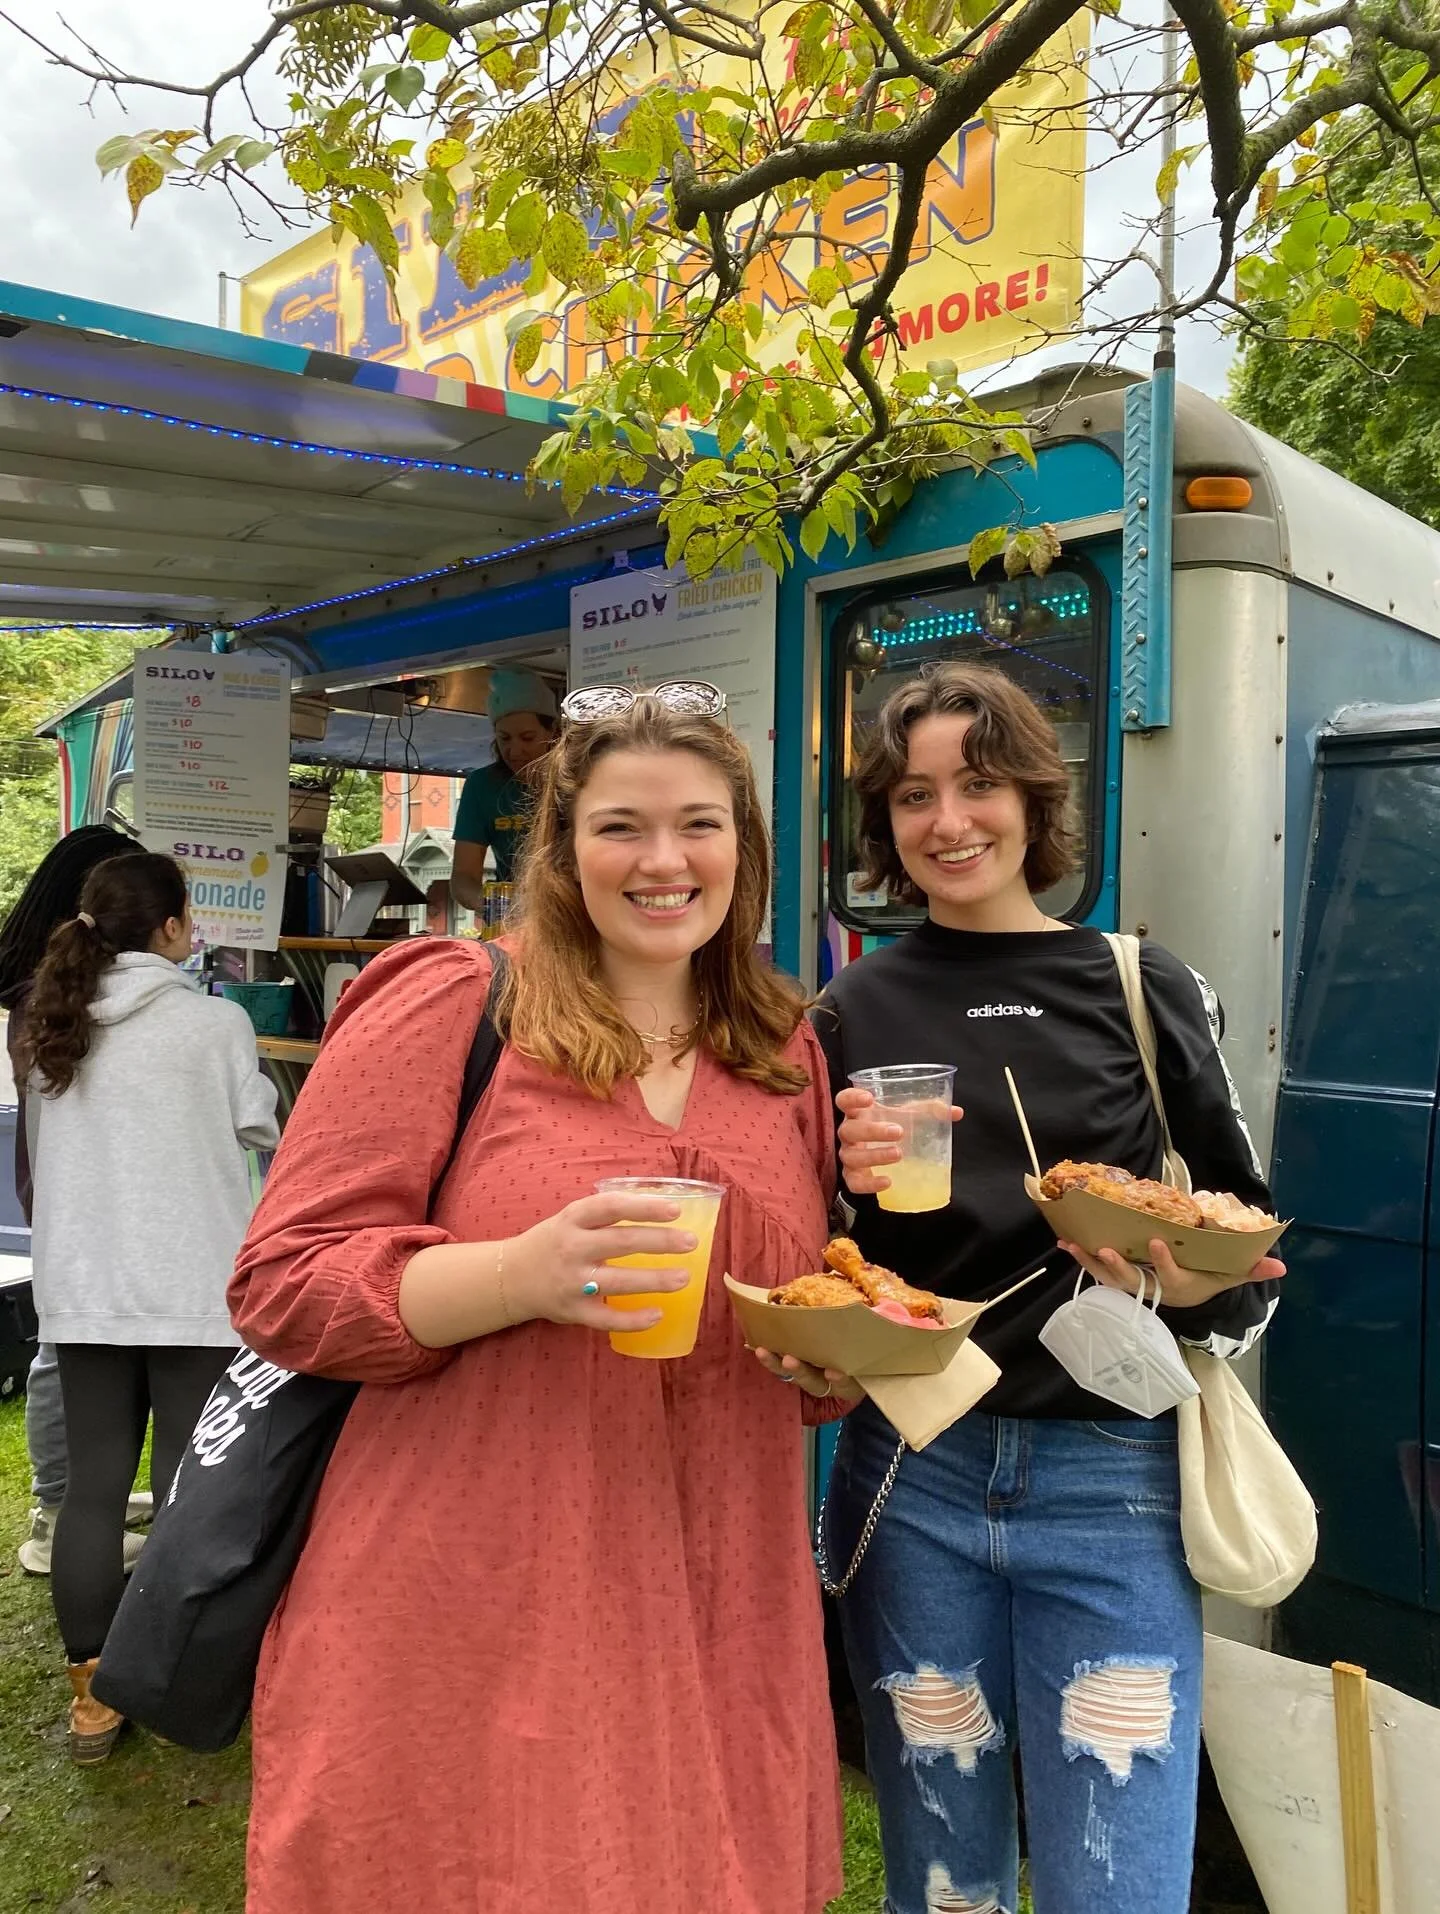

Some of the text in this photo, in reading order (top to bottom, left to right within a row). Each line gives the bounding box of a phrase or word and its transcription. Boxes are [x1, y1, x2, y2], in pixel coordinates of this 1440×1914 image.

[677, 584, 709, 609] FRIED
[711, 572, 763, 601] CHICKEN
[582, 598, 649, 631] SILO
[145, 666, 201, 681] SILO
[185, 695, 203, 708] $8
[171, 718, 193, 729] $10
[182, 739, 203, 750] $10
[179, 760, 201, 771] $10
[208, 780, 230, 791] $12
[173, 842, 246, 862] SILO
[186, 879, 267, 912] onade
[966, 1003, 1024, 1018] adidas
